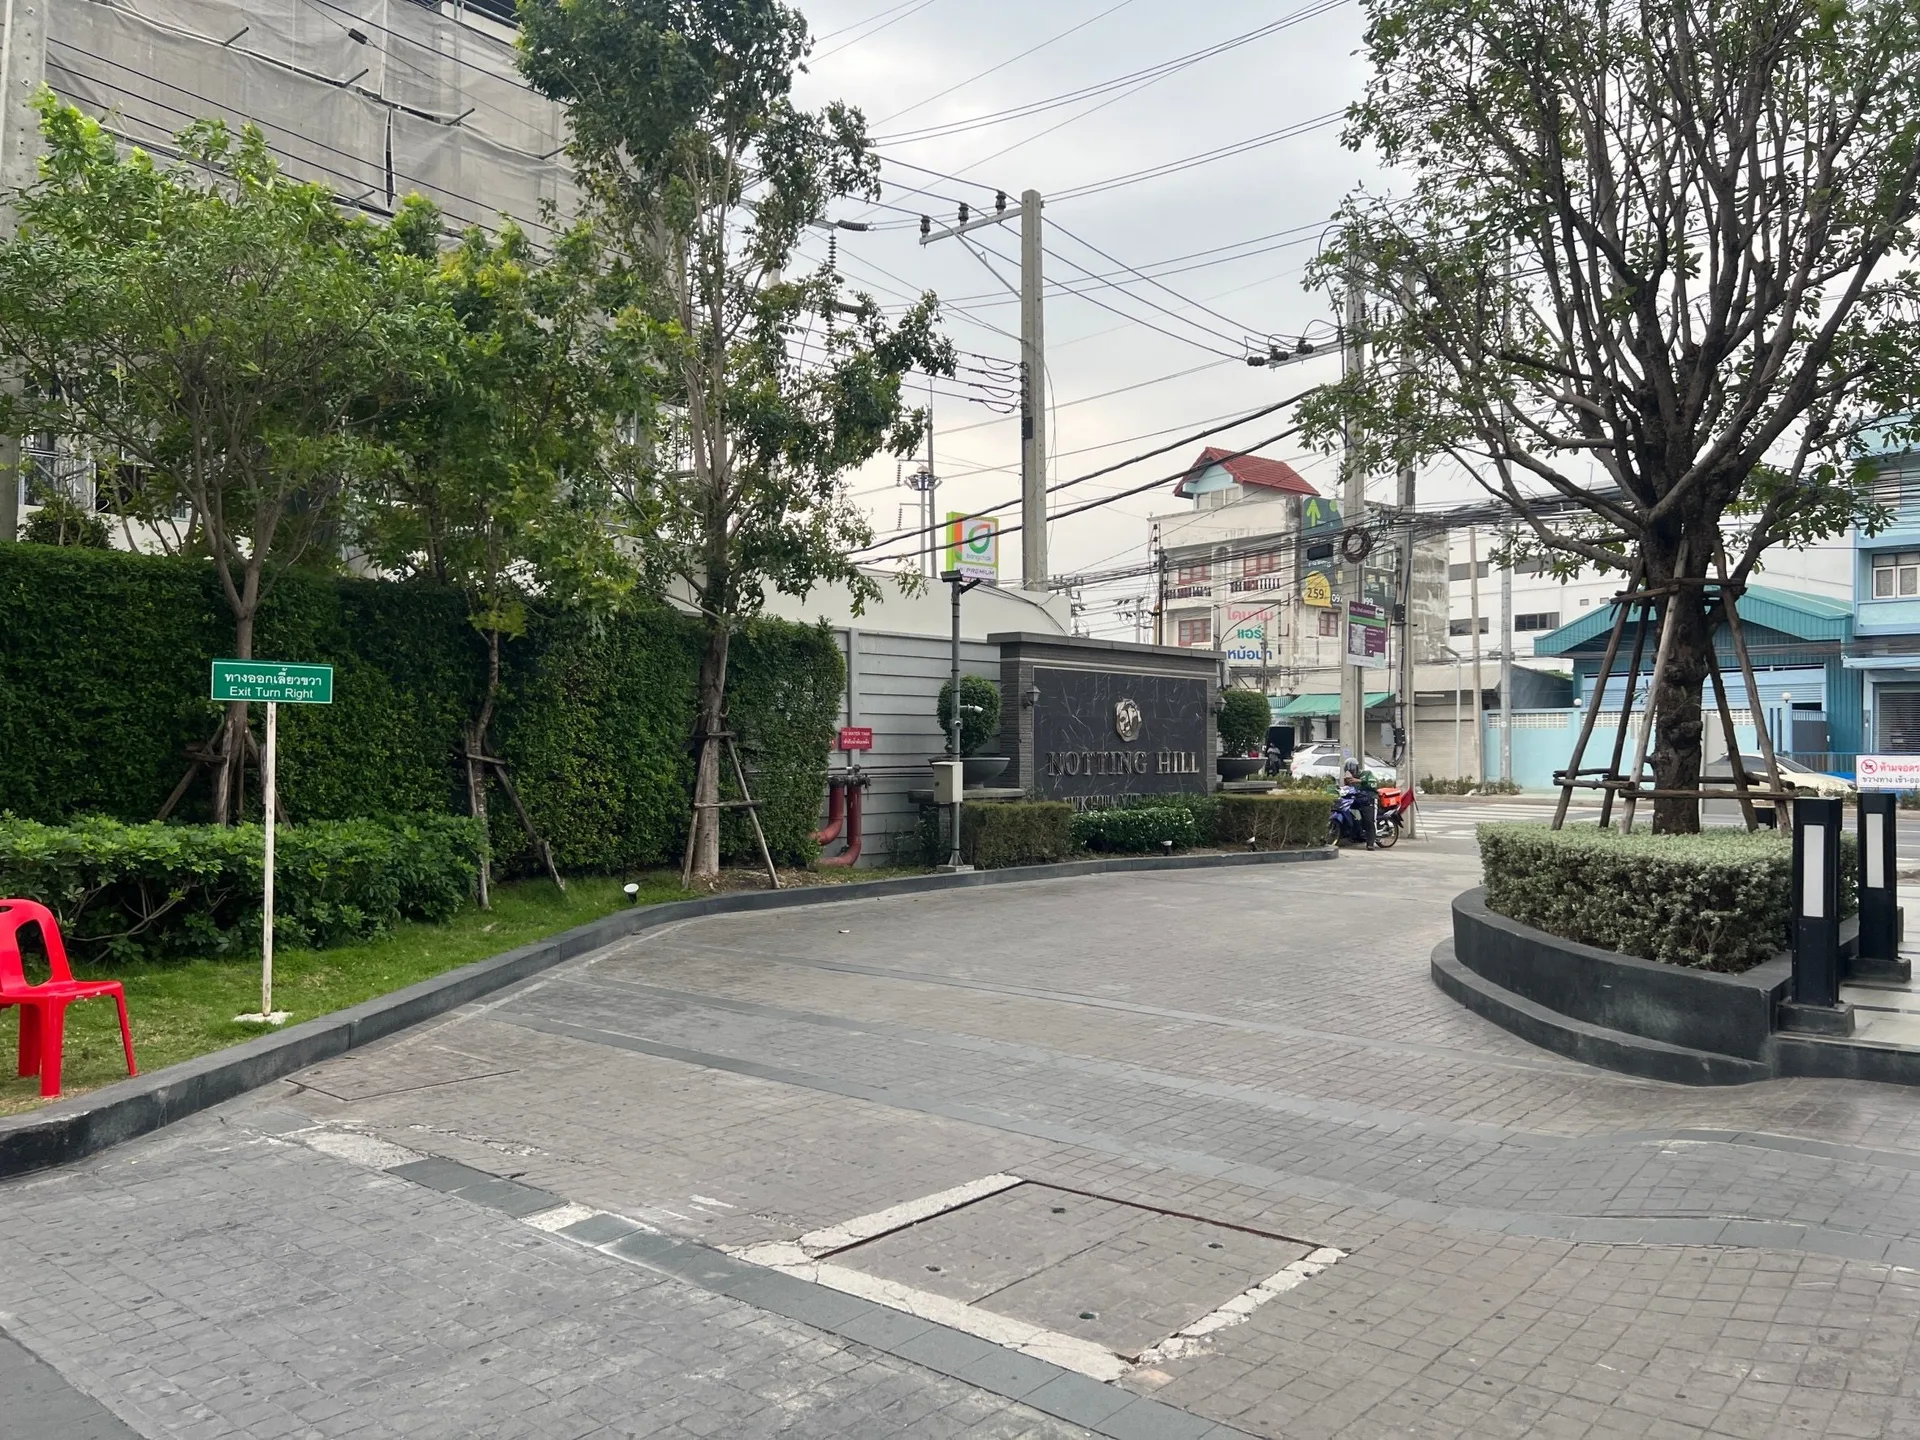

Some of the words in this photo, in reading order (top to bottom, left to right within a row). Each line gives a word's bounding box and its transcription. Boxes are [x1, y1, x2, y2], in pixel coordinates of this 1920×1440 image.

[224, 668, 322, 686] ทางออกเลี้ยวขวา
[229, 686, 251, 697] Exit
[255, 687, 281, 698] Turn
[285, 688, 313, 700] Right
[1046, 751, 1148, 776] NOTTING
[1156, 751, 1200, 774] HILL
